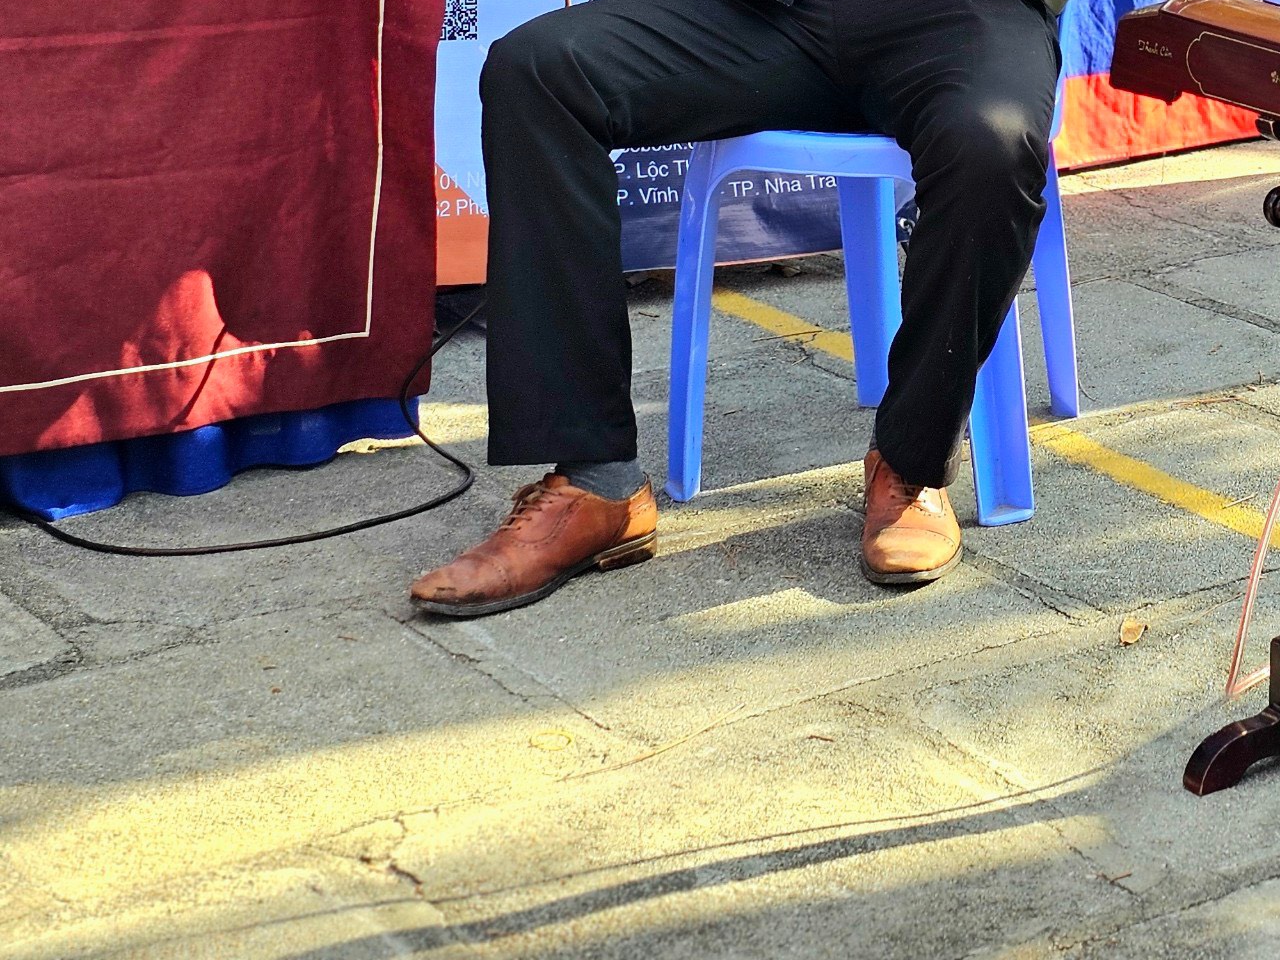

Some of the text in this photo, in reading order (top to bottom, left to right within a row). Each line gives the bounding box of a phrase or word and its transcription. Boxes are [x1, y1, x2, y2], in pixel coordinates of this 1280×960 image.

[636, 159, 669, 181] Lộc
[638, 186, 679, 204] Vĩnh
[728, 180, 759, 198] TP.
[765, 177, 802, 195] Nha
[437, 200, 451, 217] 2
